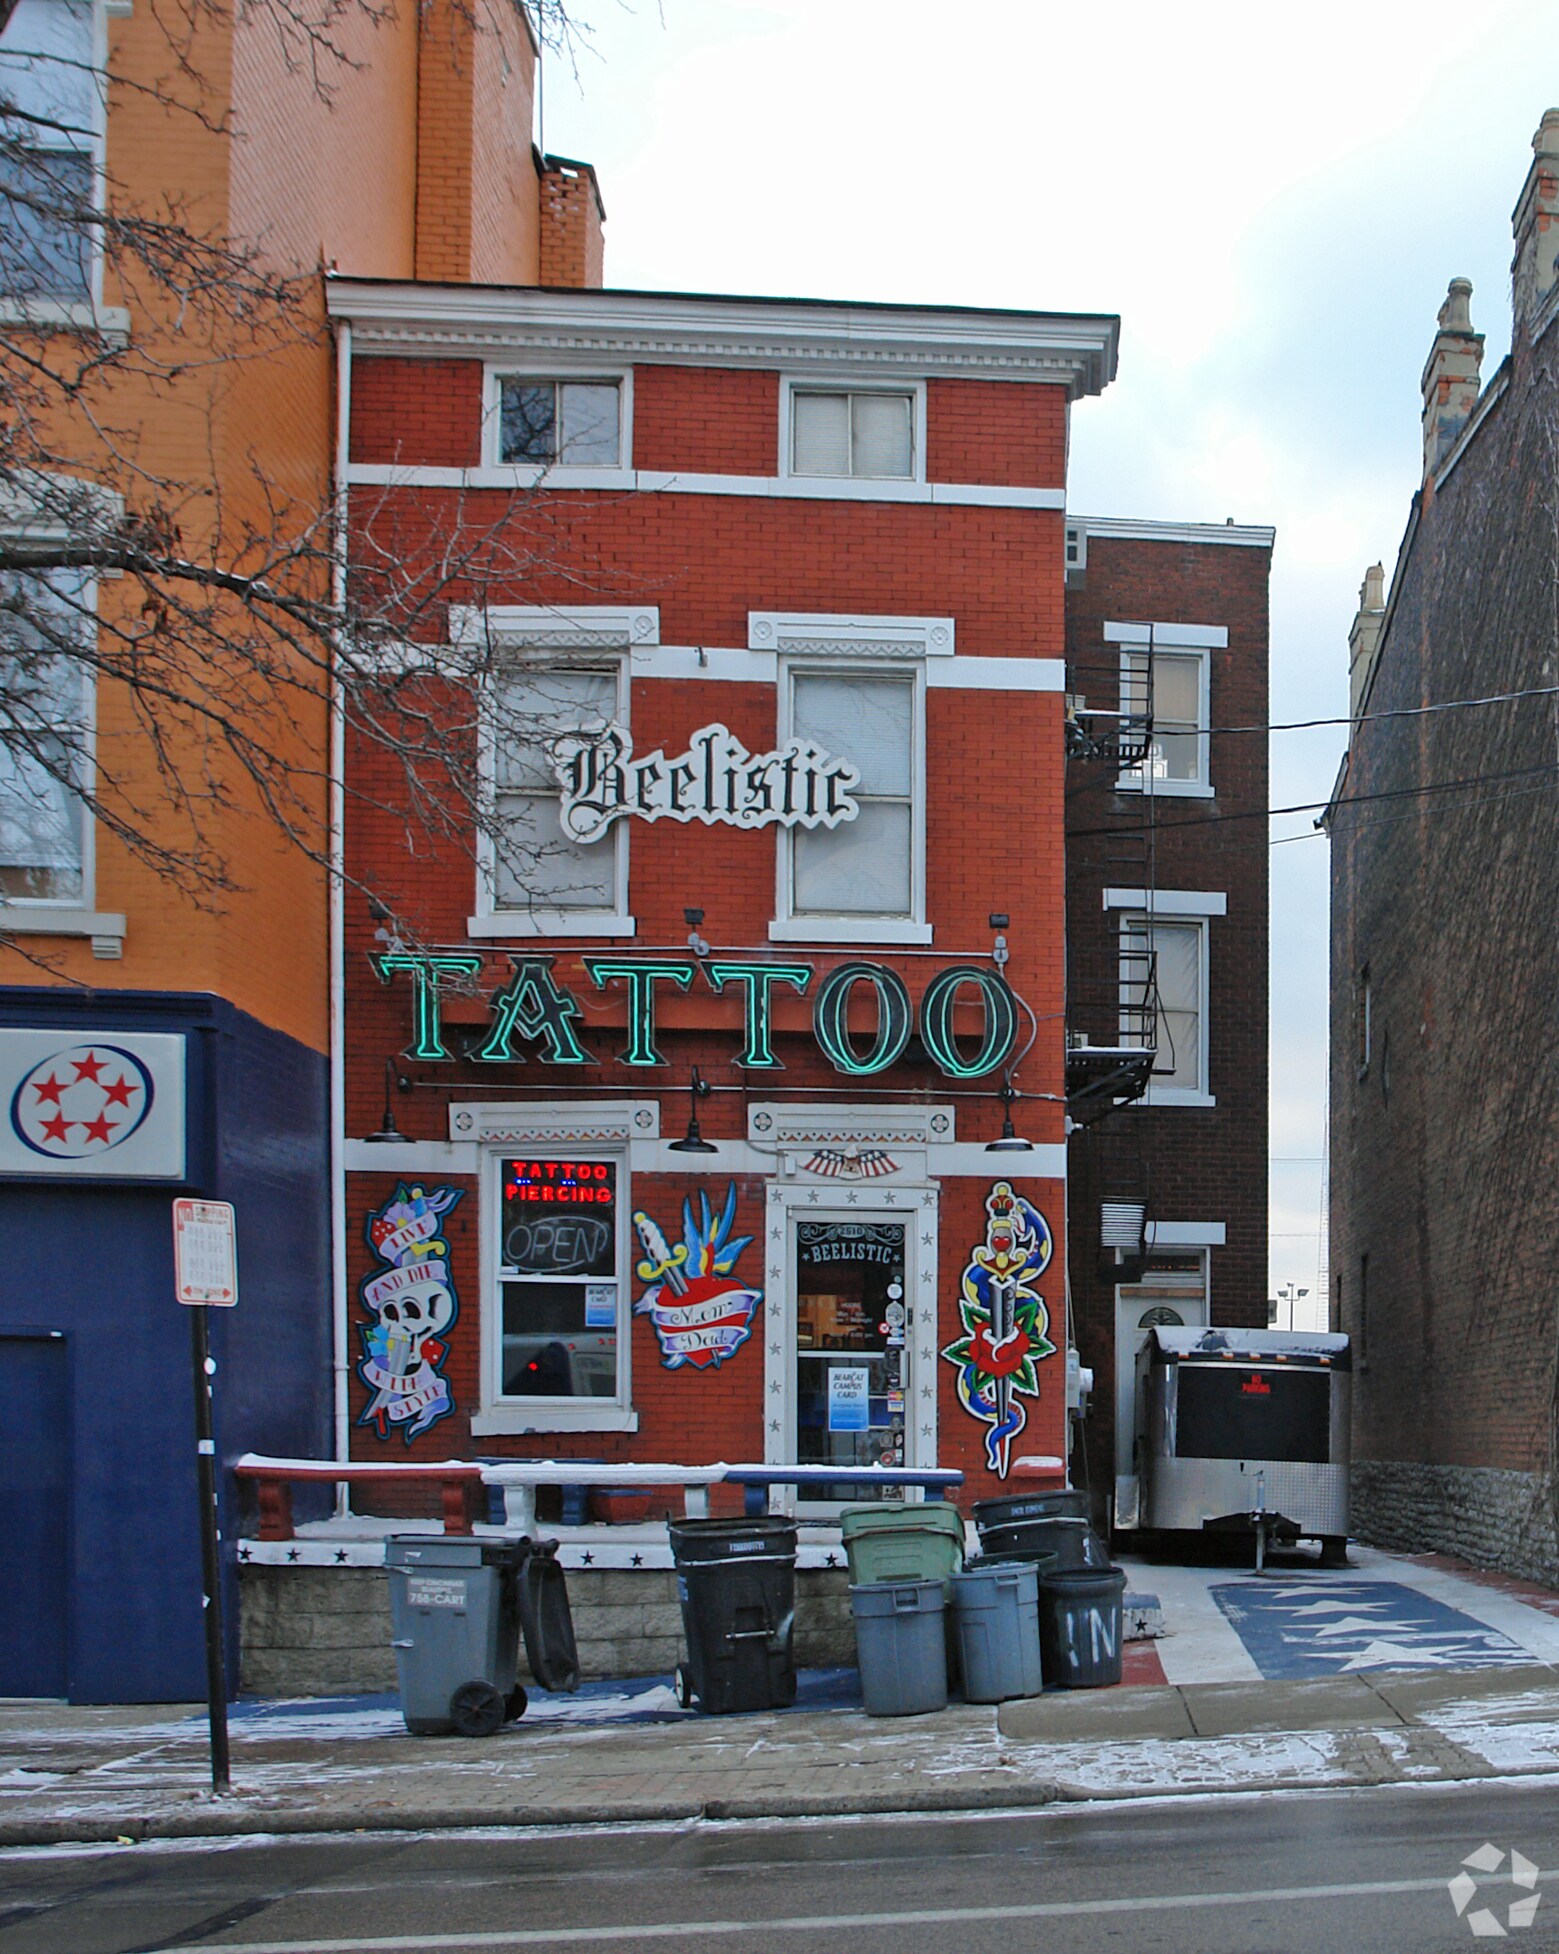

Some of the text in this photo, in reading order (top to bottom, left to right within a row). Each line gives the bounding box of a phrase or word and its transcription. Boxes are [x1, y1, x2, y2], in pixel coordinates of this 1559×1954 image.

[553, 730, 853, 835] Beelistic
[366, 951, 1019, 1078] TATTOO
[512, 1161, 608, 1180] TATTOO
[506, 1184, 612, 1203] PIERCING
[390, 1220, 431, 1248] LIVE
[839, 1227, 863, 1235] 2510
[506, 1225, 600, 1263] OPEN
[811, 1243, 892, 1264] BEELISTIC
[371, 1274, 404, 1301] AND
[670, 1301, 733, 1325] Mom
[681, 1330, 728, 1350] Dad
[837, 1391, 857, 1399] CARD
